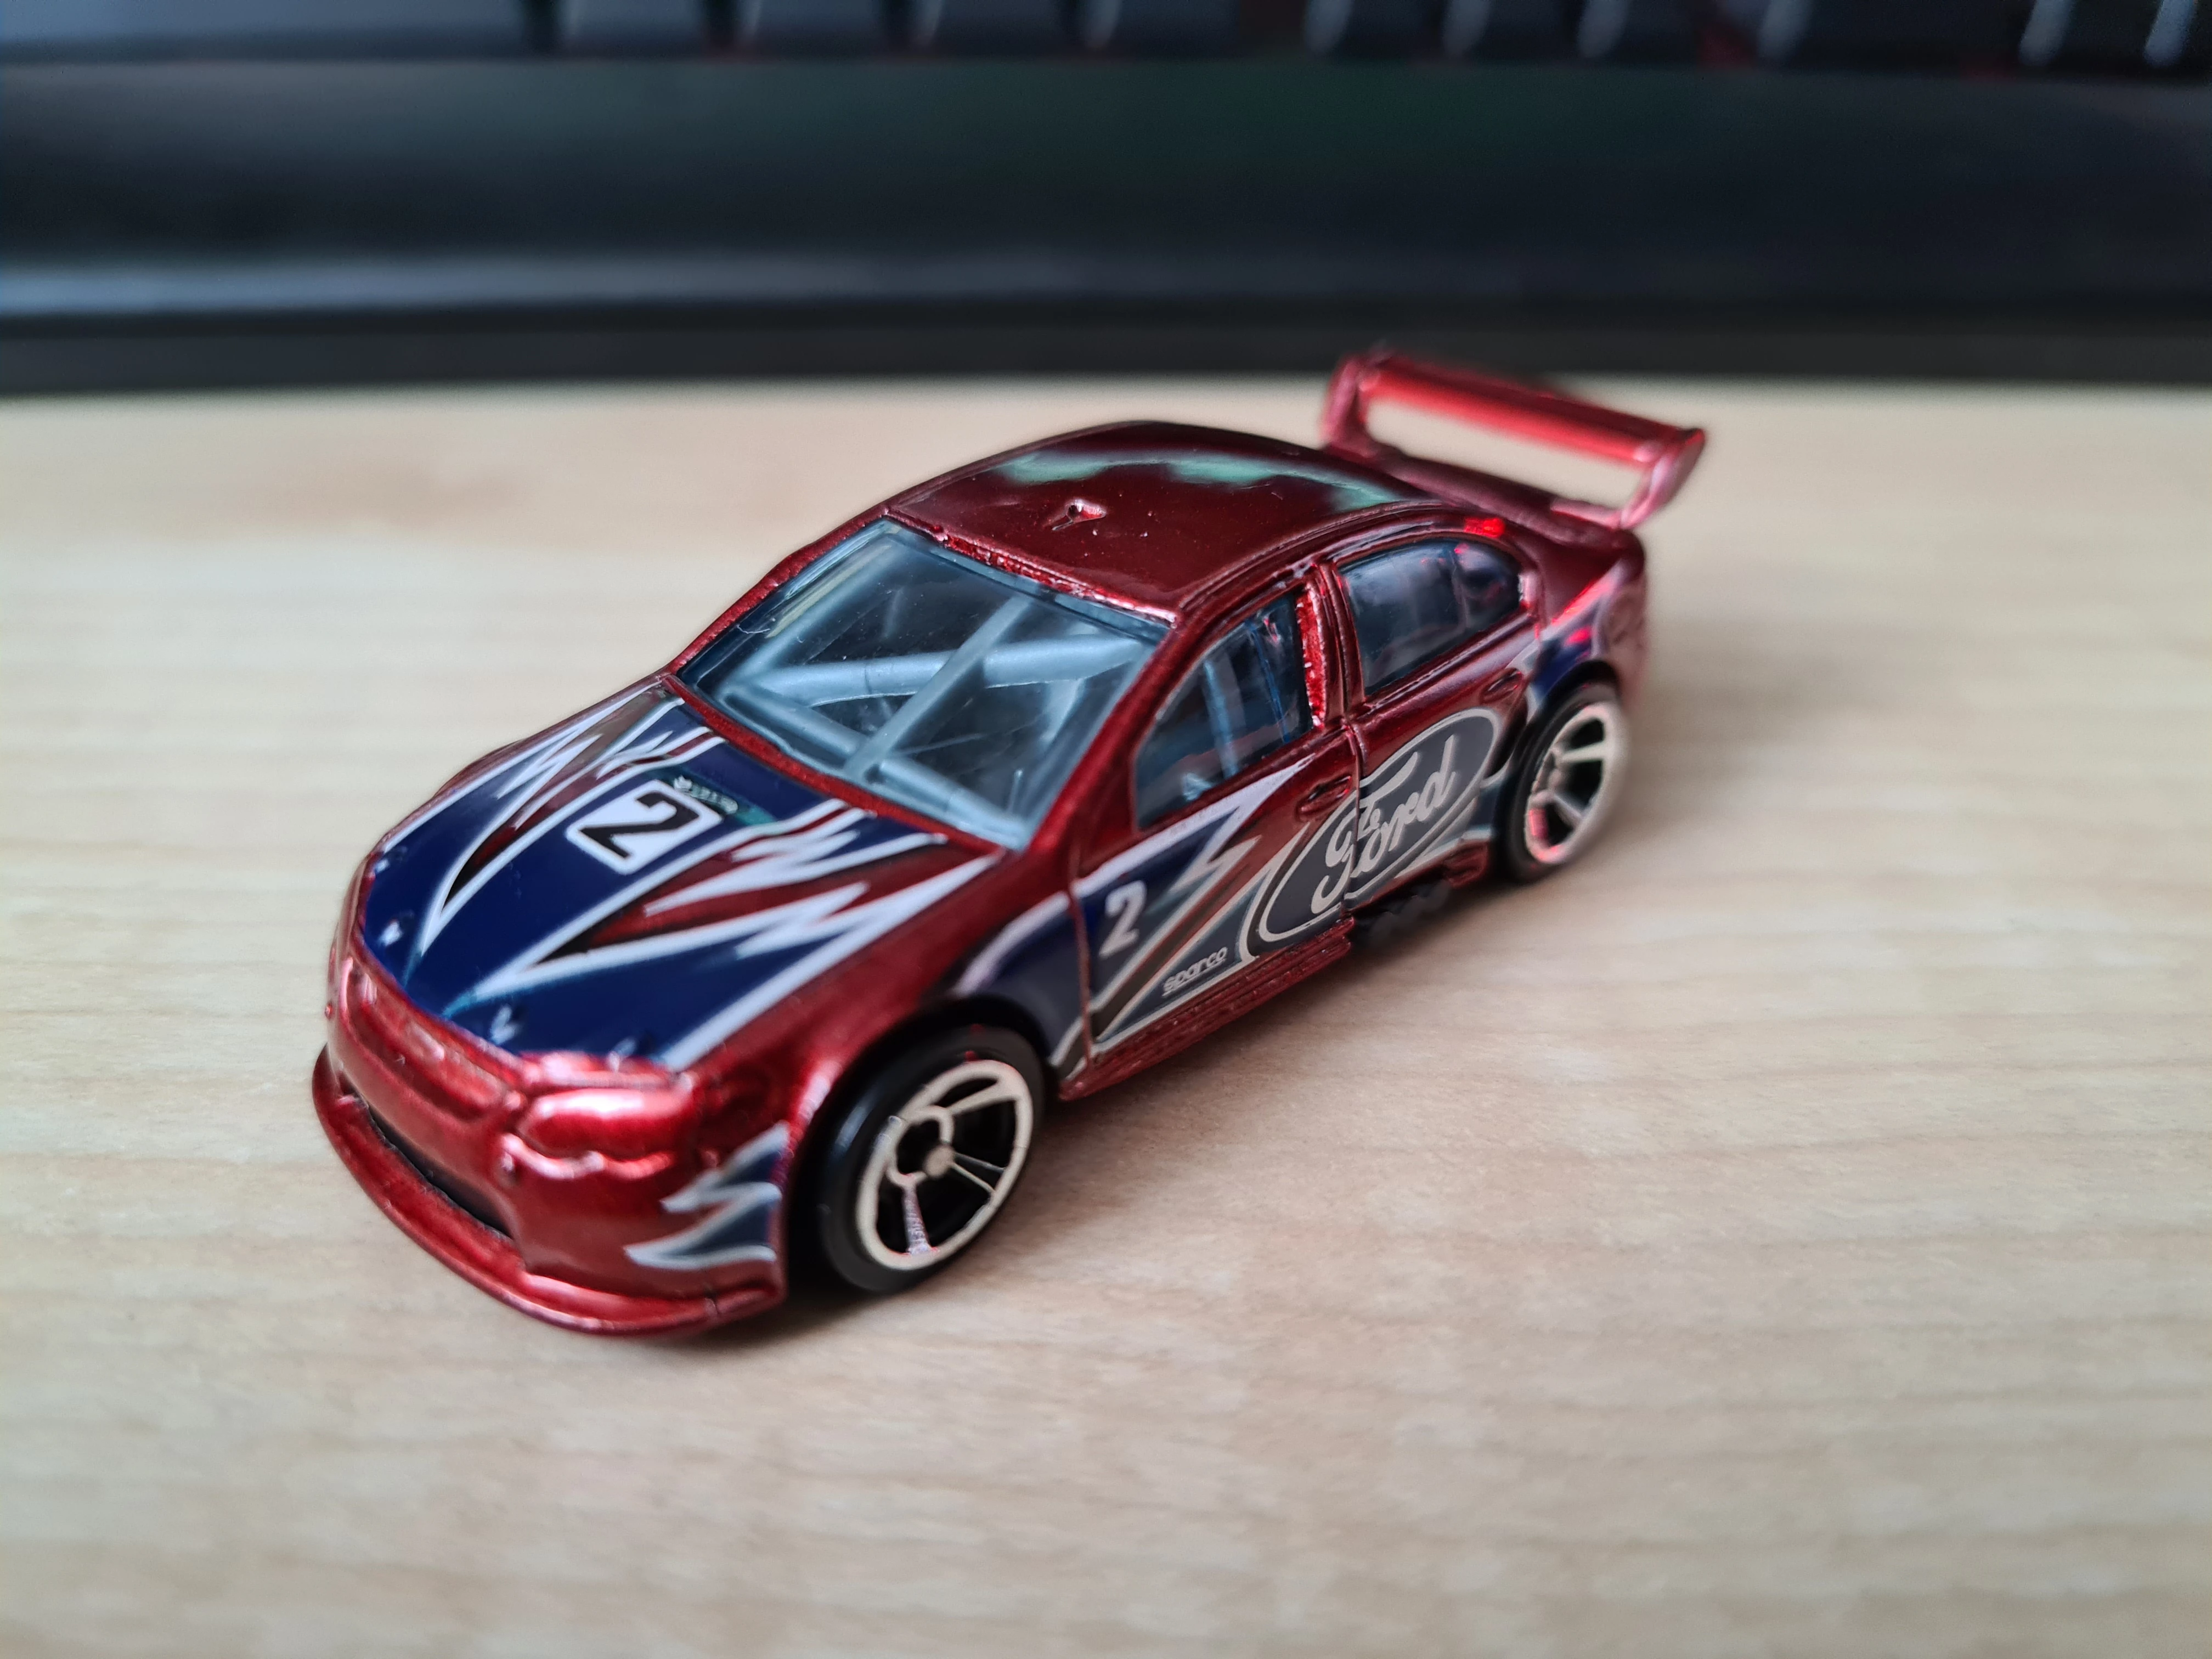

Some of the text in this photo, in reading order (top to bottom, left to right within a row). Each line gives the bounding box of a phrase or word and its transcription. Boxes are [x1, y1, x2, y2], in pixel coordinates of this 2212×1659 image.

[580, 791, 699, 859] 2
[1311, 734, 1457, 914] Ford
[1100, 880, 1146, 958] 2
[1161, 946, 1228, 996] sparco
